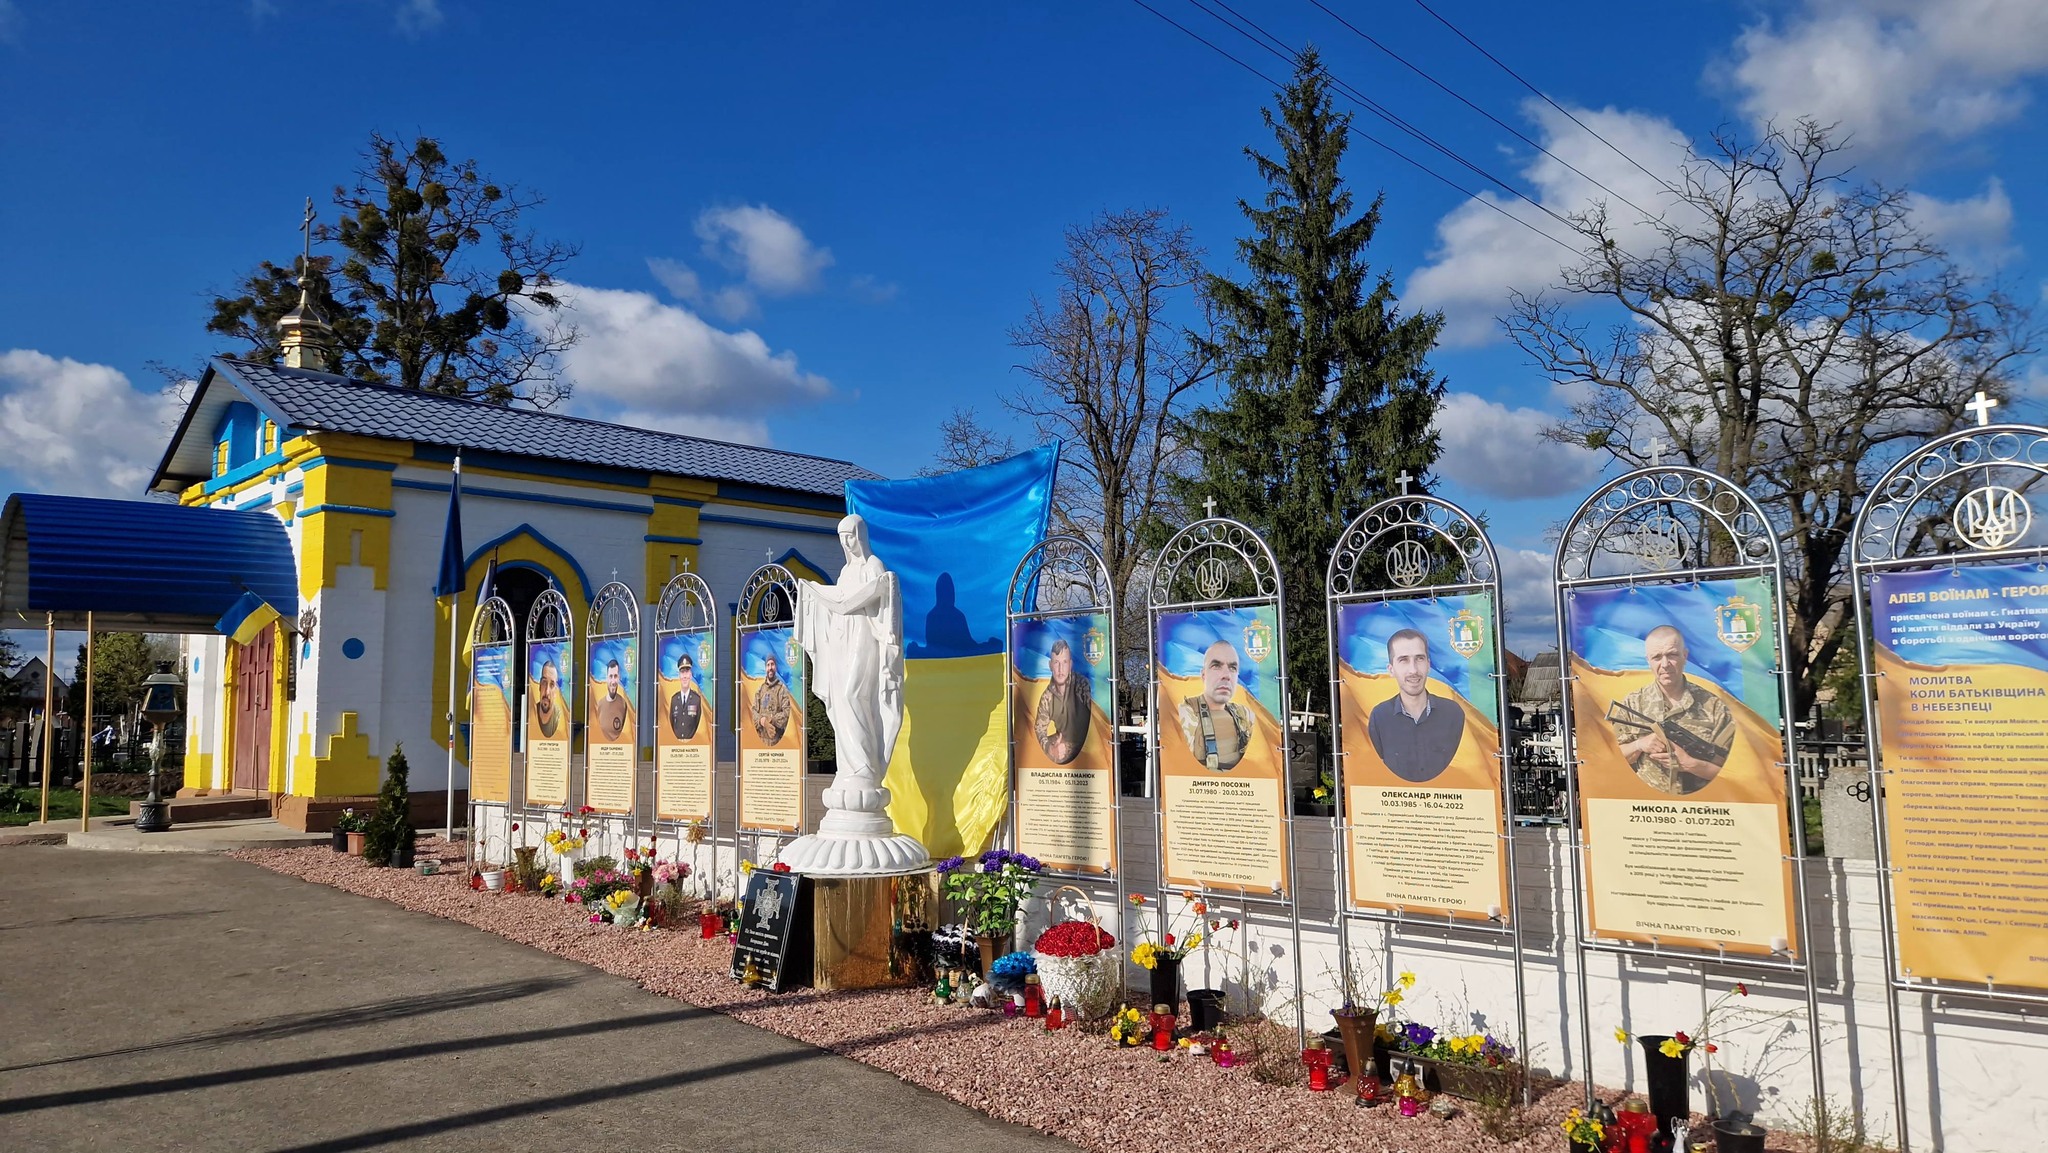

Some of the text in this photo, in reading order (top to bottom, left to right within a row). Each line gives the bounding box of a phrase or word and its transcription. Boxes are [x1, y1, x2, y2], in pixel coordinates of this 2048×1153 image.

[1889, 592, 1926, 604] АЛЕЯ
[1929, 588, 1989, 602] ВОЇНАМ
[1890, 612, 1950, 622] присвячена
[1952, 610, 1988, 618] воїнам
[1891, 625, 1906, 633] які
[1908, 625, 1939, 633] життя
[1941, 623, 1982, 632] віддали
[1998, 619, 2040, 630] Україну
[1900, 636, 1946, 646] боротьбі
[1957, 634, 2006, 643] одвічним
[2008, 633, 2048, 641] ворого
[1909, 676, 1973, 685] МОЛИТВА
[1910, 688, 2045, 699] КОЛИ БАТЬКІВЩИНА
[1911, 702, 1992, 712] В НЕБЕЗПЕЦІ
[1382, 791, 1431, 800] ОЛЕКСАНДР
[1381, 800, 1417, 808] 10.03.1985
[1424, 802, 1464, 810] 16.04.2022
[1632, 805, 1730, 816] МИКОЛА АЛЄЙНІК
[1629, 815, 1676, 824] 27.10.1980
[1685, 817, 1735, 826] 01.07.2021
[1408, 894, 1436, 902] ПАМ'ЯТЬ
[1664, 923, 1702, 932] ПАМ'ЯТЬ
[1704, 927, 1736, 936] ГЕРОЮ
